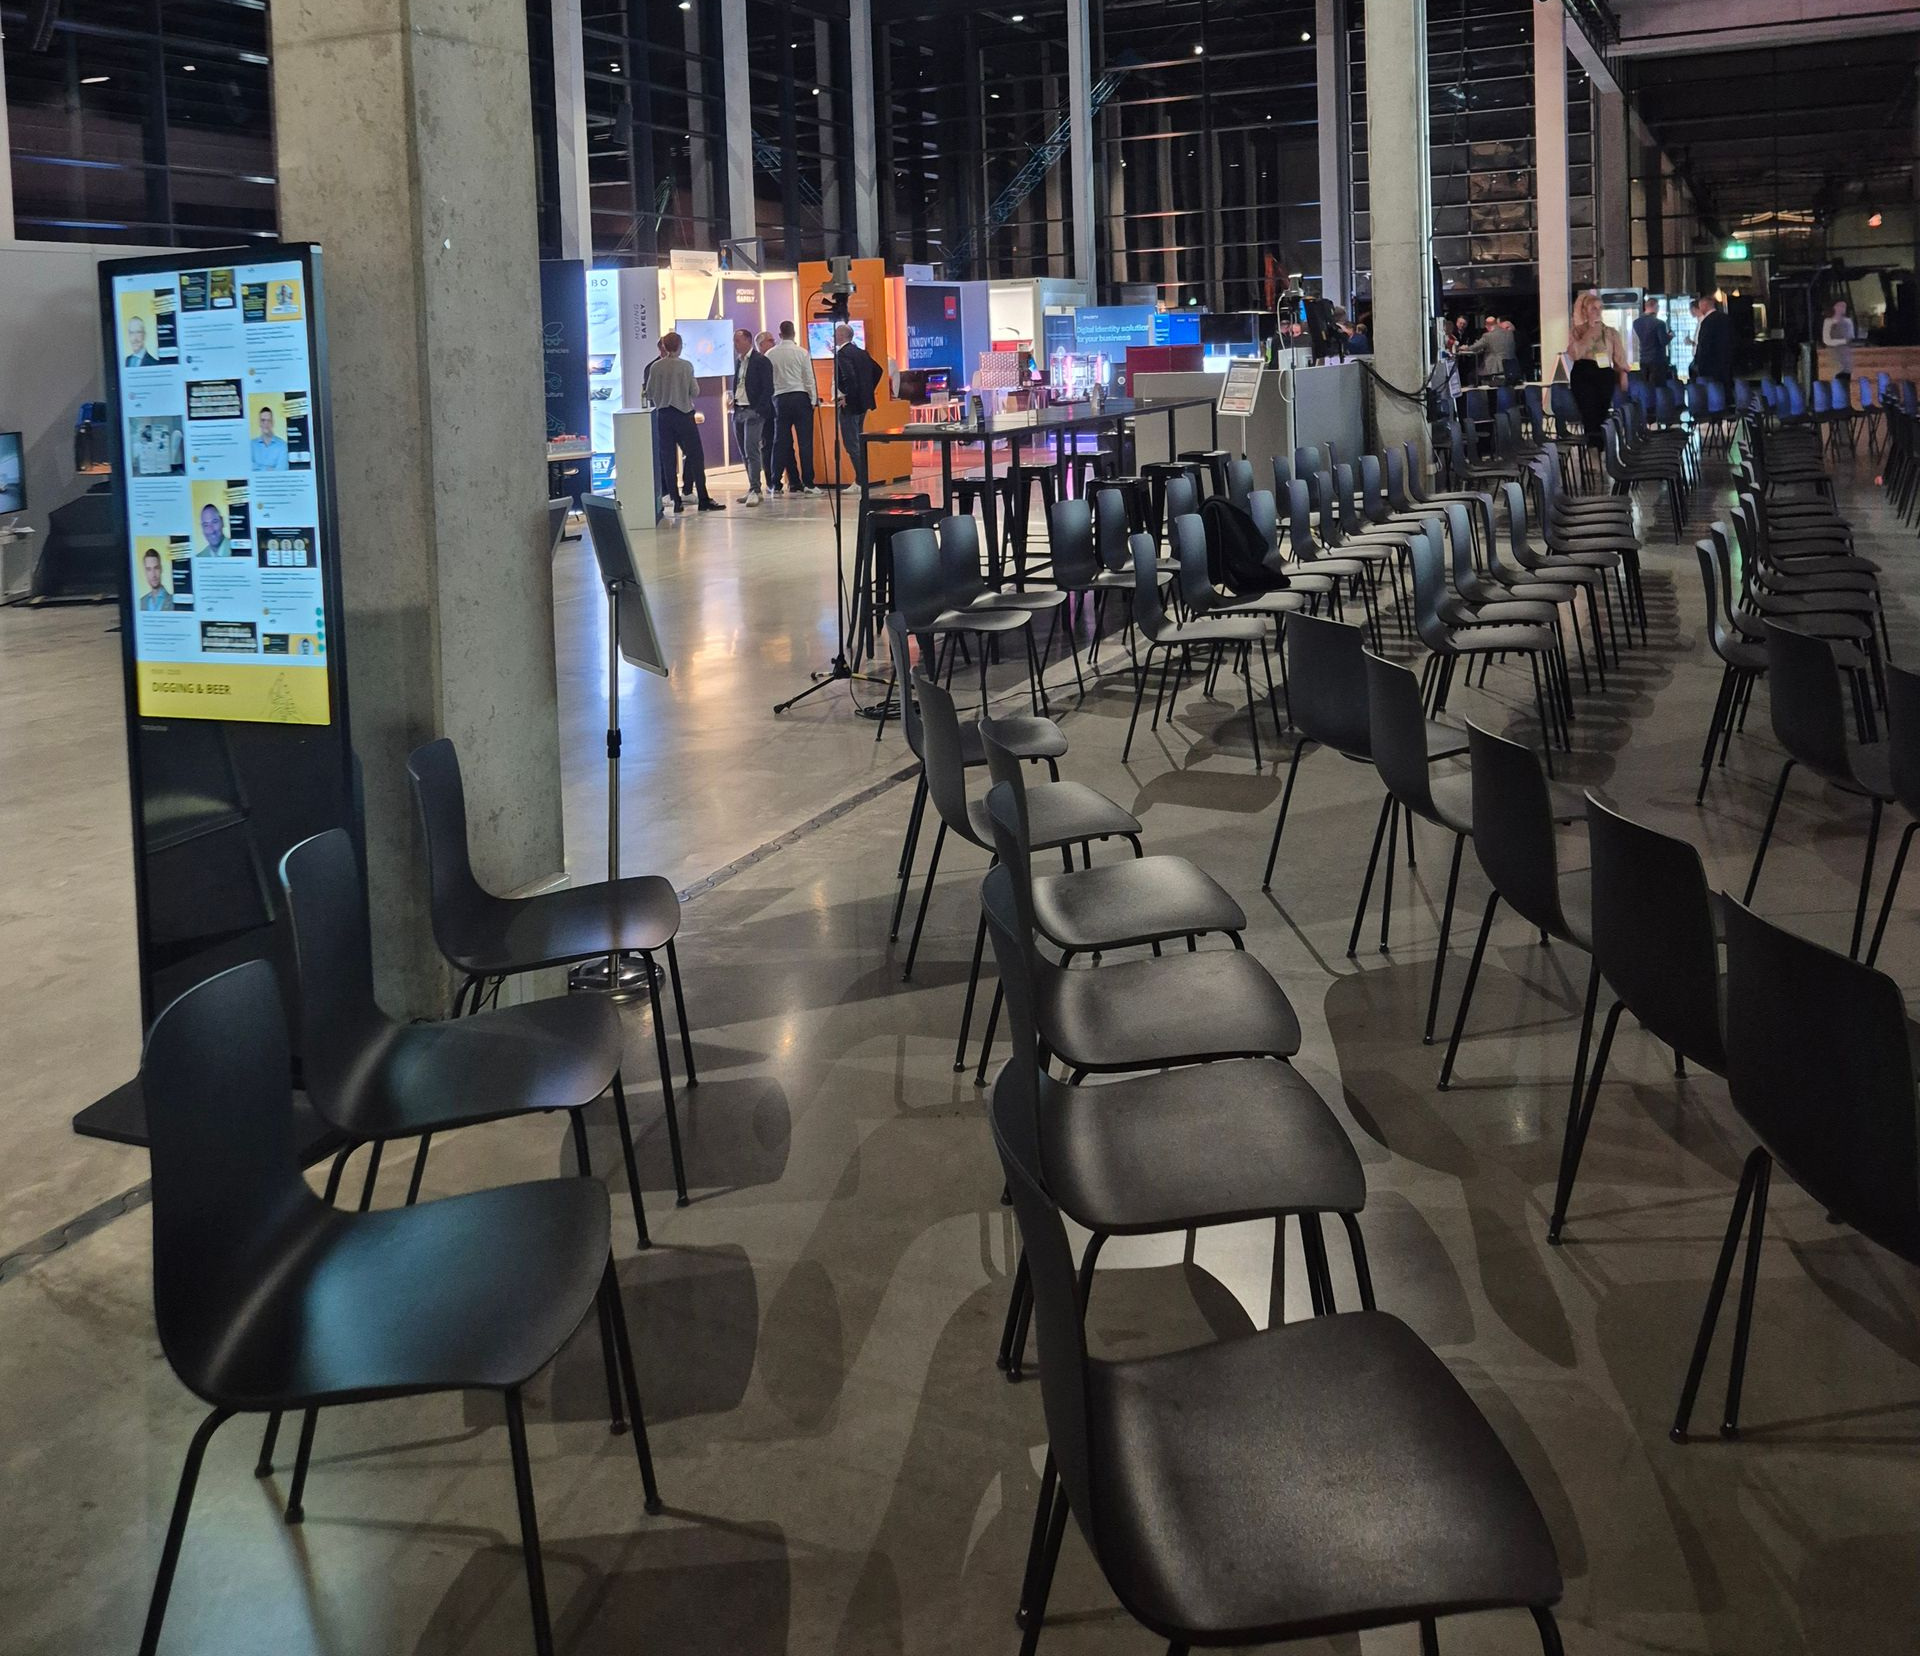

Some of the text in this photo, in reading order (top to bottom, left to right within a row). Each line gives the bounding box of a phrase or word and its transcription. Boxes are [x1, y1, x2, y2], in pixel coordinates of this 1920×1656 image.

[633, 303, 641, 341] MOVING
[1099, 334, 1132, 342] business
[152, 682, 232, 695] DIGGING & BEER
